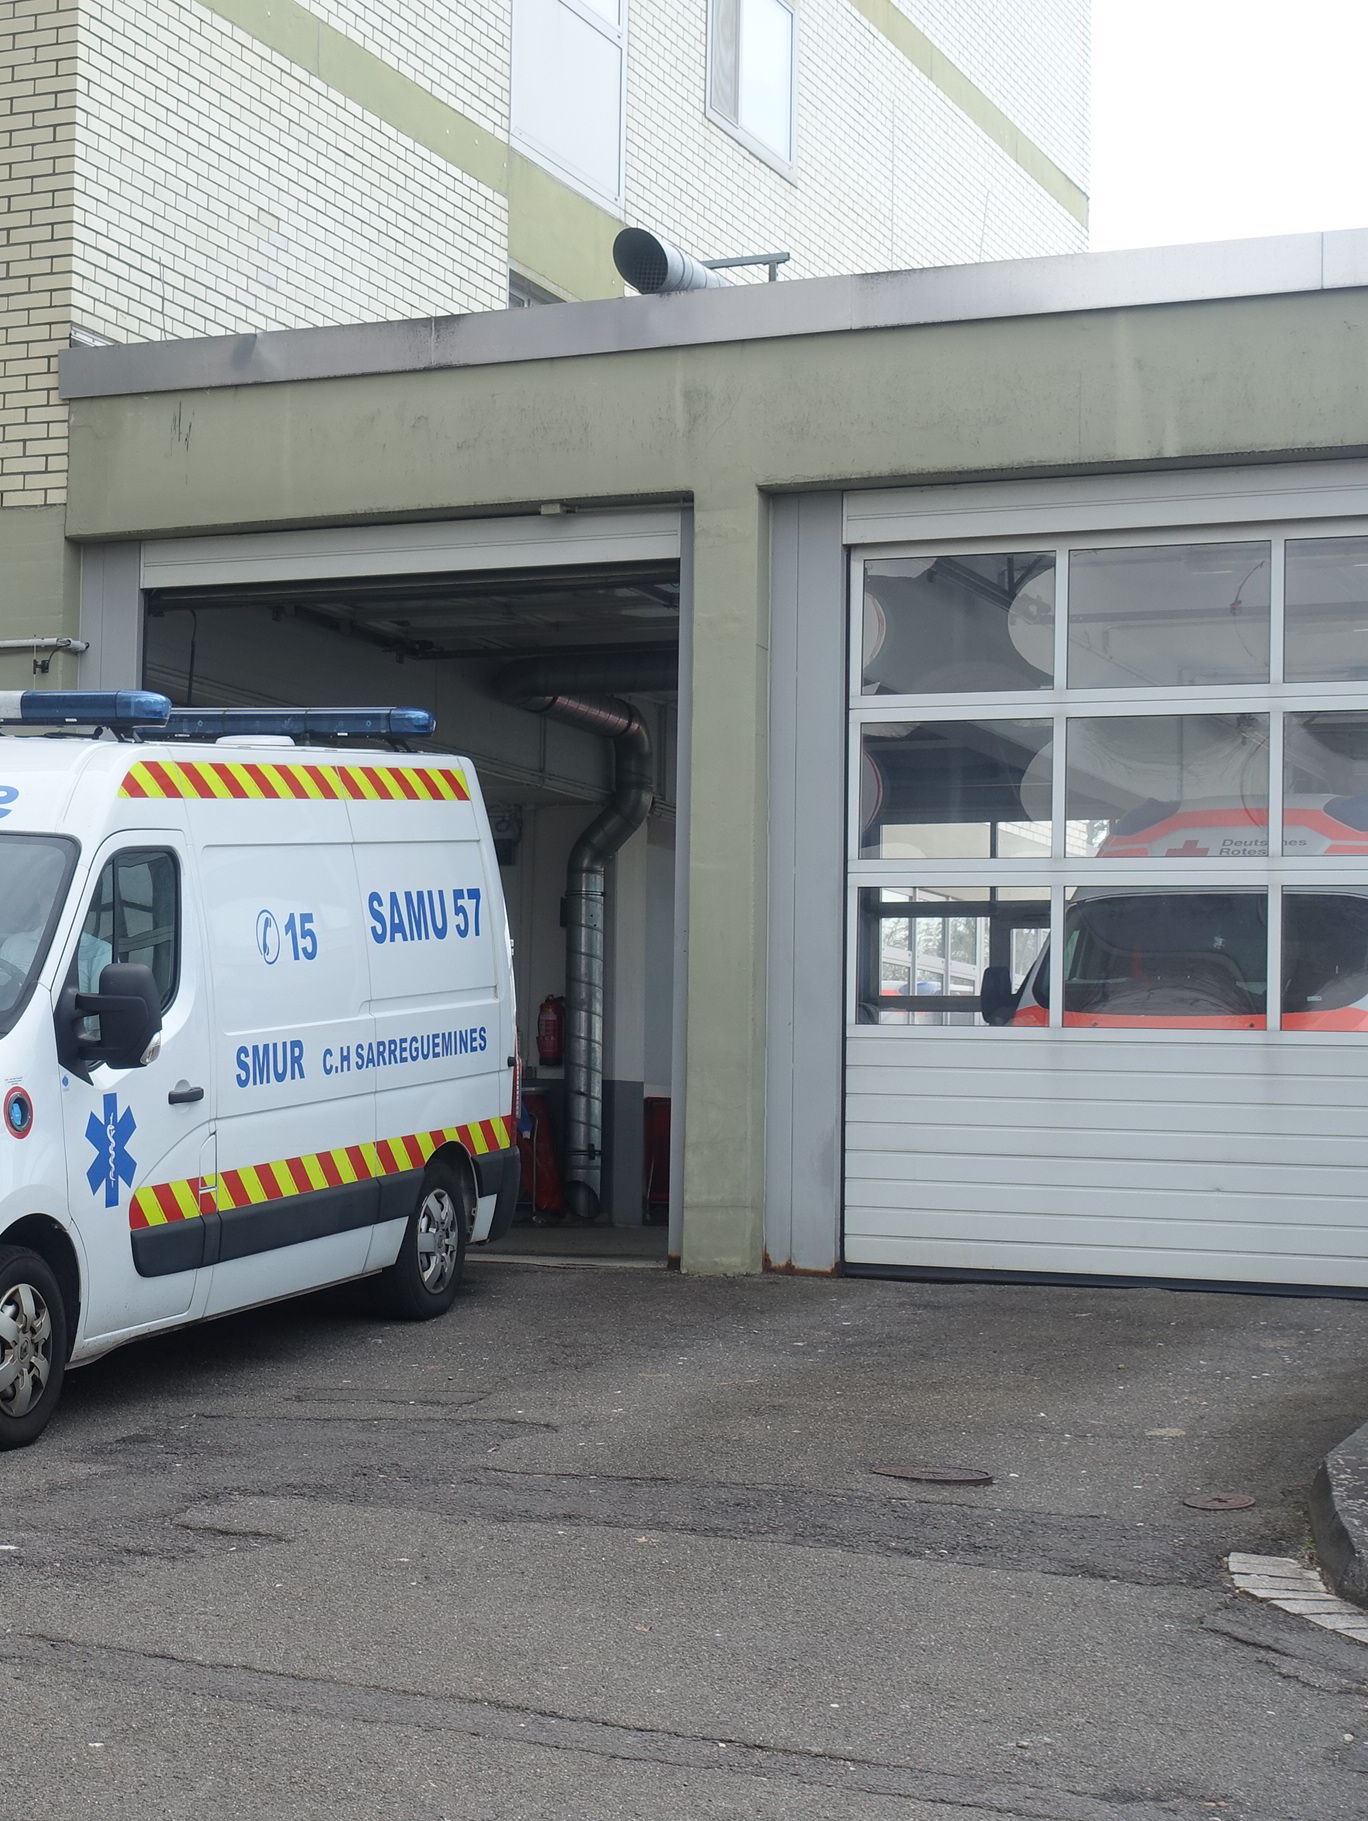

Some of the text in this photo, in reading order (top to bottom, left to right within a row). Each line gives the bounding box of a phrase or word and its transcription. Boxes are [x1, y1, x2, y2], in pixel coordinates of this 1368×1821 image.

[284, 912, 318, 961] 15
[368, 888, 481, 944] SAMU 57
[235, 1039, 306, 1088] SMUR
[322, 1046, 351, 1076] C.H
[355, 1026, 487, 1071] SARREGUEMINES
